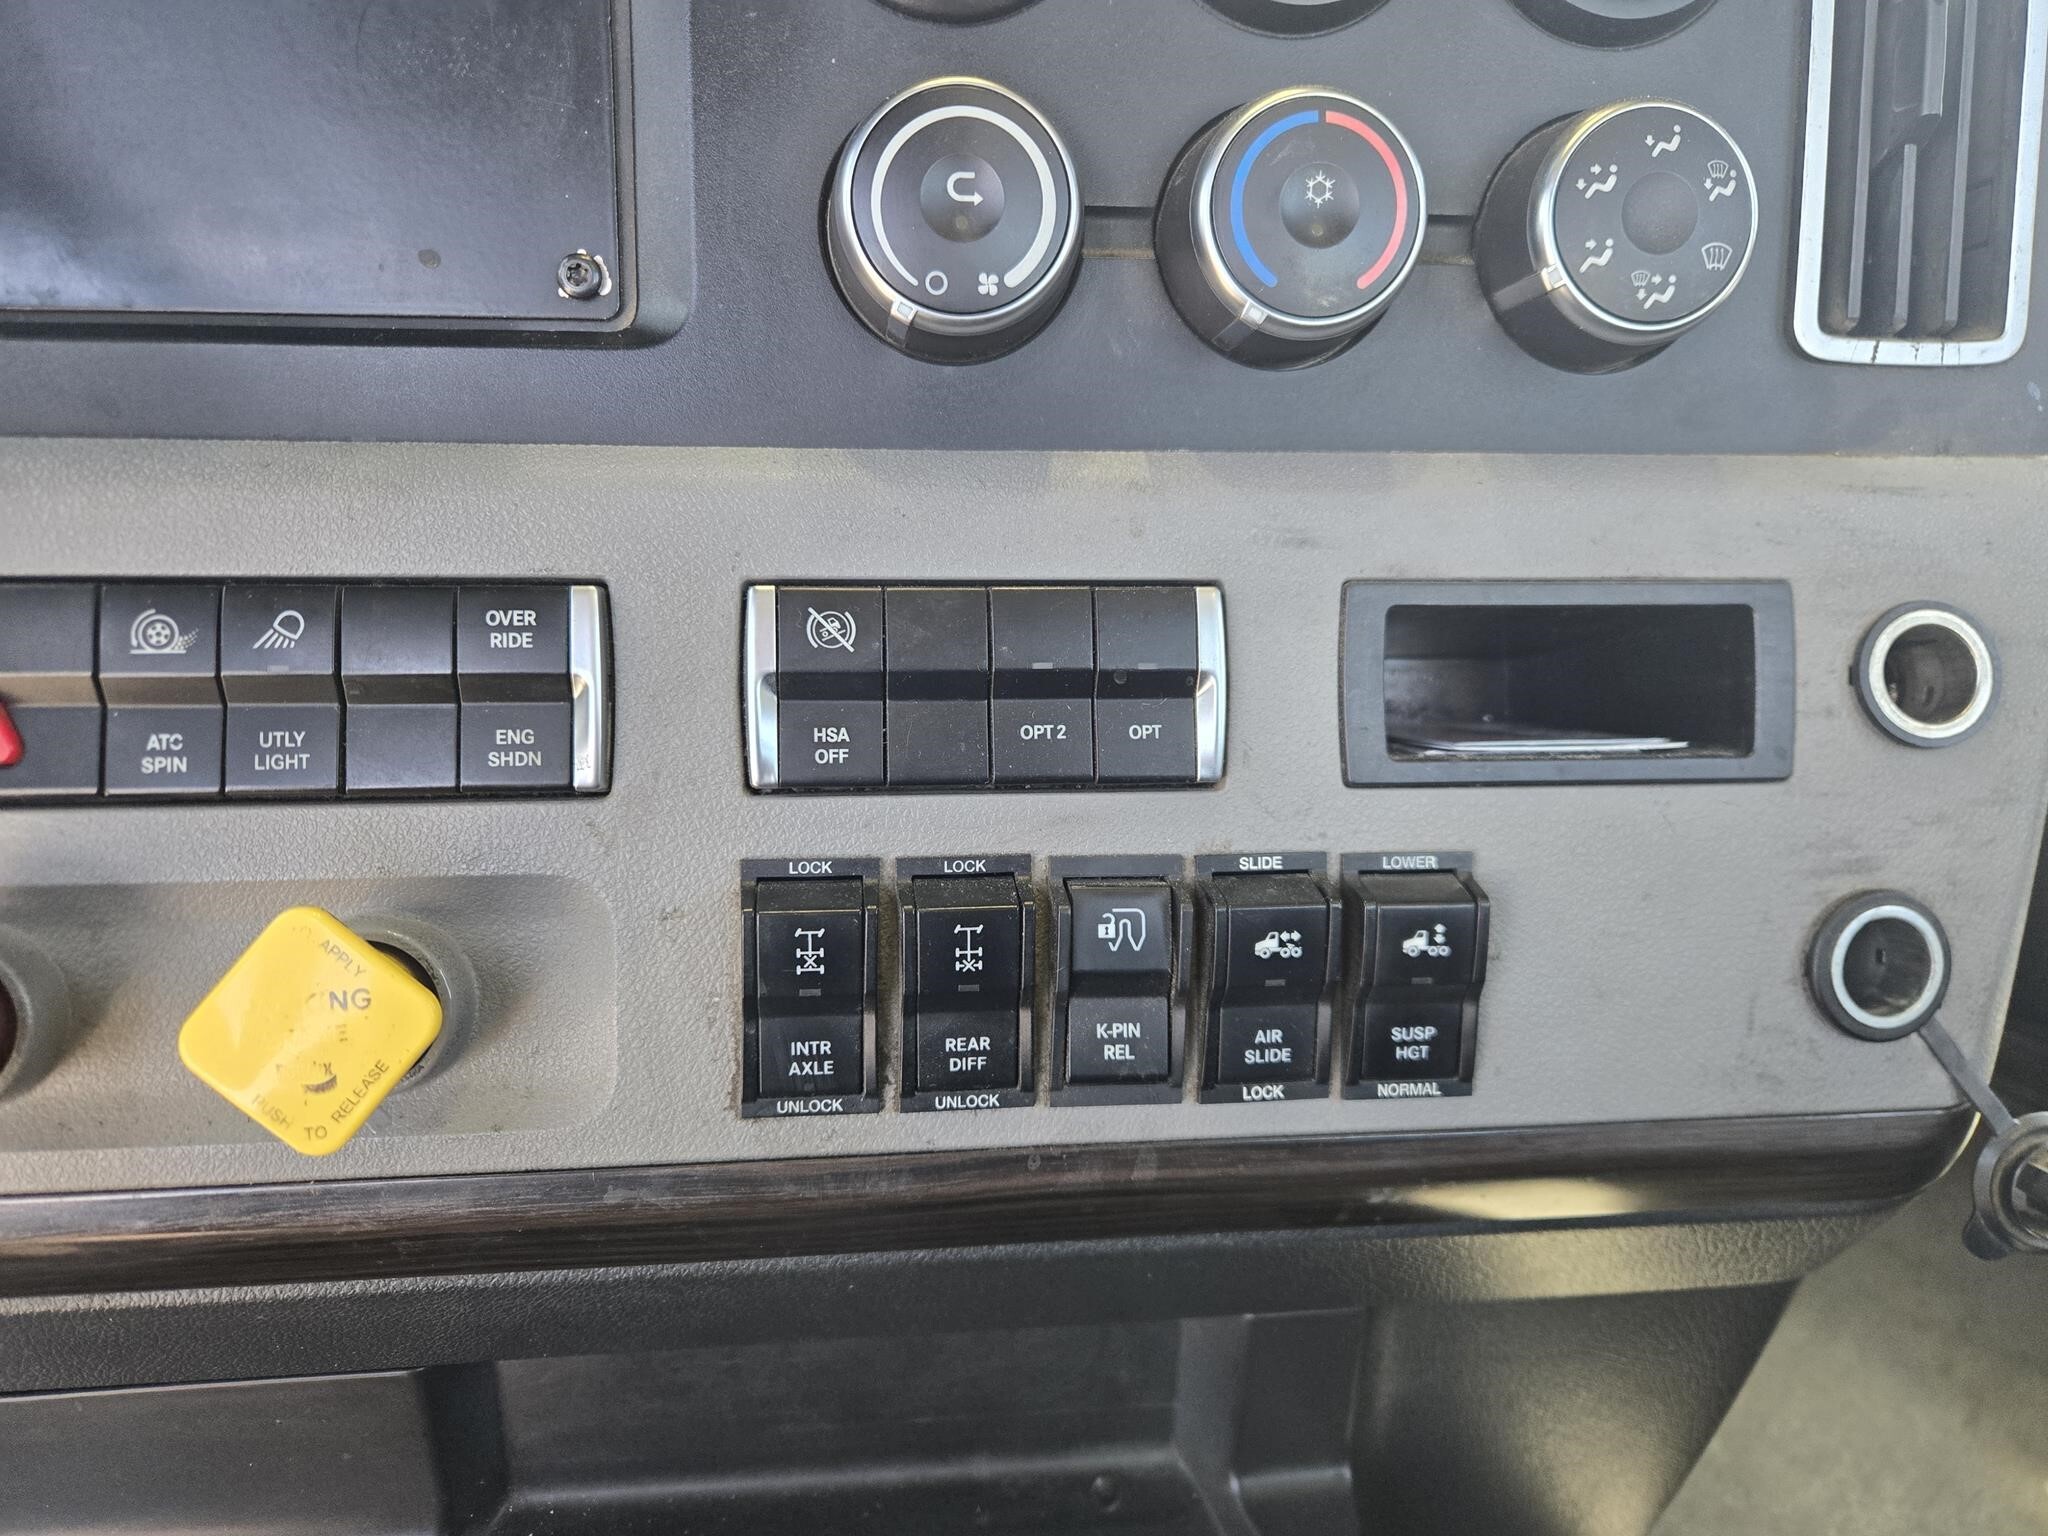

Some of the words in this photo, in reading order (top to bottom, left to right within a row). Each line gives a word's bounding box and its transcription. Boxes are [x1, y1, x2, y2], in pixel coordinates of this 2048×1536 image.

[485, 609, 537, 627] OVER
[490, 632, 534, 649] RIDE
[259, 731, 306, 748] UTLY
[495, 728, 535, 745] ENG
[813, 727, 851, 743] HSA
[1020, 724, 1055, 740] OPT
[1056, 724, 1067, 740] 2
[1128, 724, 1162, 740] OPT
[146, 733, 183, 751] ATC
[254, 753, 311, 771] LIGHT
[487, 751, 542, 768] SHDN
[814, 748, 849, 764] OFF
[141, 756, 188, 774] SPIN
[788, 860, 833, 875] LOCK
[943, 859, 987, 873] LOCK
[1239, 855, 1283, 871] SLIDE
[1382, 855, 1439, 870] LOWER
[319, 939, 367, 977] APPLY
[1096, 1022, 1141, 1039] K-PIN
[1254, 1029, 1283, 1044] AIR
[1390, 1025, 1437, 1042] SUSP
[790, 1040, 832, 1056] INTR
[945, 1036, 991, 1053] REAR
[1103, 1043, 1136, 1060] REL
[1395, 1045, 1429, 1060] HGT
[949, 1056, 987, 1072] DIFF
[1244, 1047, 1292, 1065] SLIDE
[788, 1060, 834, 1076] AXLE
[1242, 1084, 1285, 1101] LOCK
[1377, 1081, 1442, 1097] NORMAL
[304, 1125, 328, 1141] TO
[331, 1059, 390, 1123] RELEASE
[776, 1098, 844, 1114] UNLOCK
[934, 1093, 1000, 1110] UNLOCK
